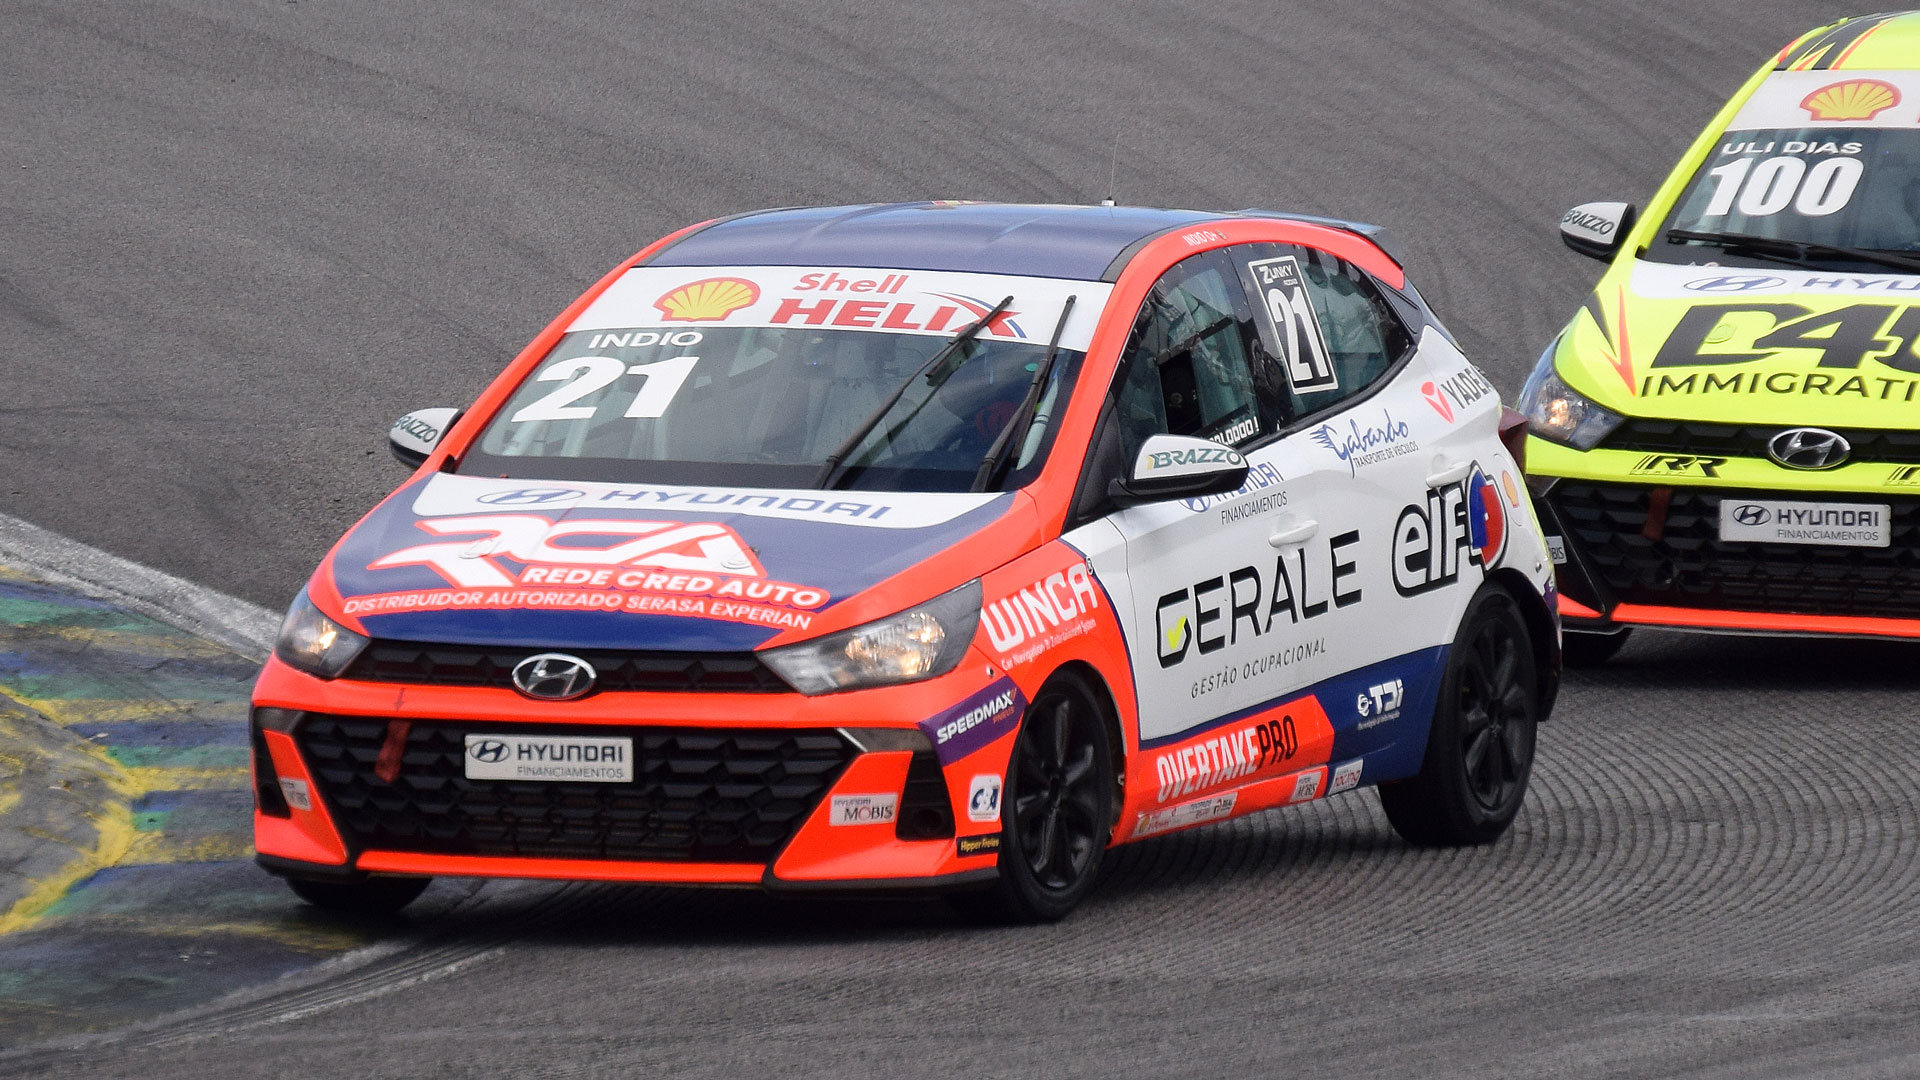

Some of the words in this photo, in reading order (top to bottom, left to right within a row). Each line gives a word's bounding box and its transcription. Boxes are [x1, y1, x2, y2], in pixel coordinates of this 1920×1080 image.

[1721, 142, 1774, 155] ULI
[1786, 141, 1864, 155] DIAS
[1705, 157, 1864, 217] 100
[1562, 209, 1615, 235] BRAZZO
[793, 272, 910, 295] Shell
[769, 297, 1022, 338] HELIX
[1268, 286, 1329, 382] 21
[588, 331, 703, 349] INDIO
[510, 356, 700, 423] 21
[1148, 448, 1242, 469] BRAZZO
[600, 488, 892, 520] HYUNDAI
[1220, 490, 1288, 525] FINANCIAMENTOS
[1777, 508, 1879, 527] HYUNDAI
[370, 513, 765, 588] RCA
[1393, 486, 1467, 597] elf
[1777, 529, 1880, 541] FINANCIAMENTOS
[521, 566, 612, 587] REDE
[618, 570, 714, 593] CRED
[719, 580, 822, 606] AUTO
[1156, 529, 1362, 669] GERALE
[343, 591, 483, 614] DISTRIBUIDOR
[485, 591, 623, 608] AUTORIZADO
[627, 595, 705, 613] SERASA
[710, 602, 812, 630] EXPERIAN
[980, 562, 1098, 653] WINCA
[1191, 665, 1238, 698] GESTÃO
[1243, 637, 1327, 680] OCUPACIONAL
[936, 690, 1014, 745] SPEEDMAX
[517, 743, 623, 762] HYUNDAI
[517, 766, 624, 779] FINANCIAMENTOS
[843, 805, 894, 822] MOBIS
